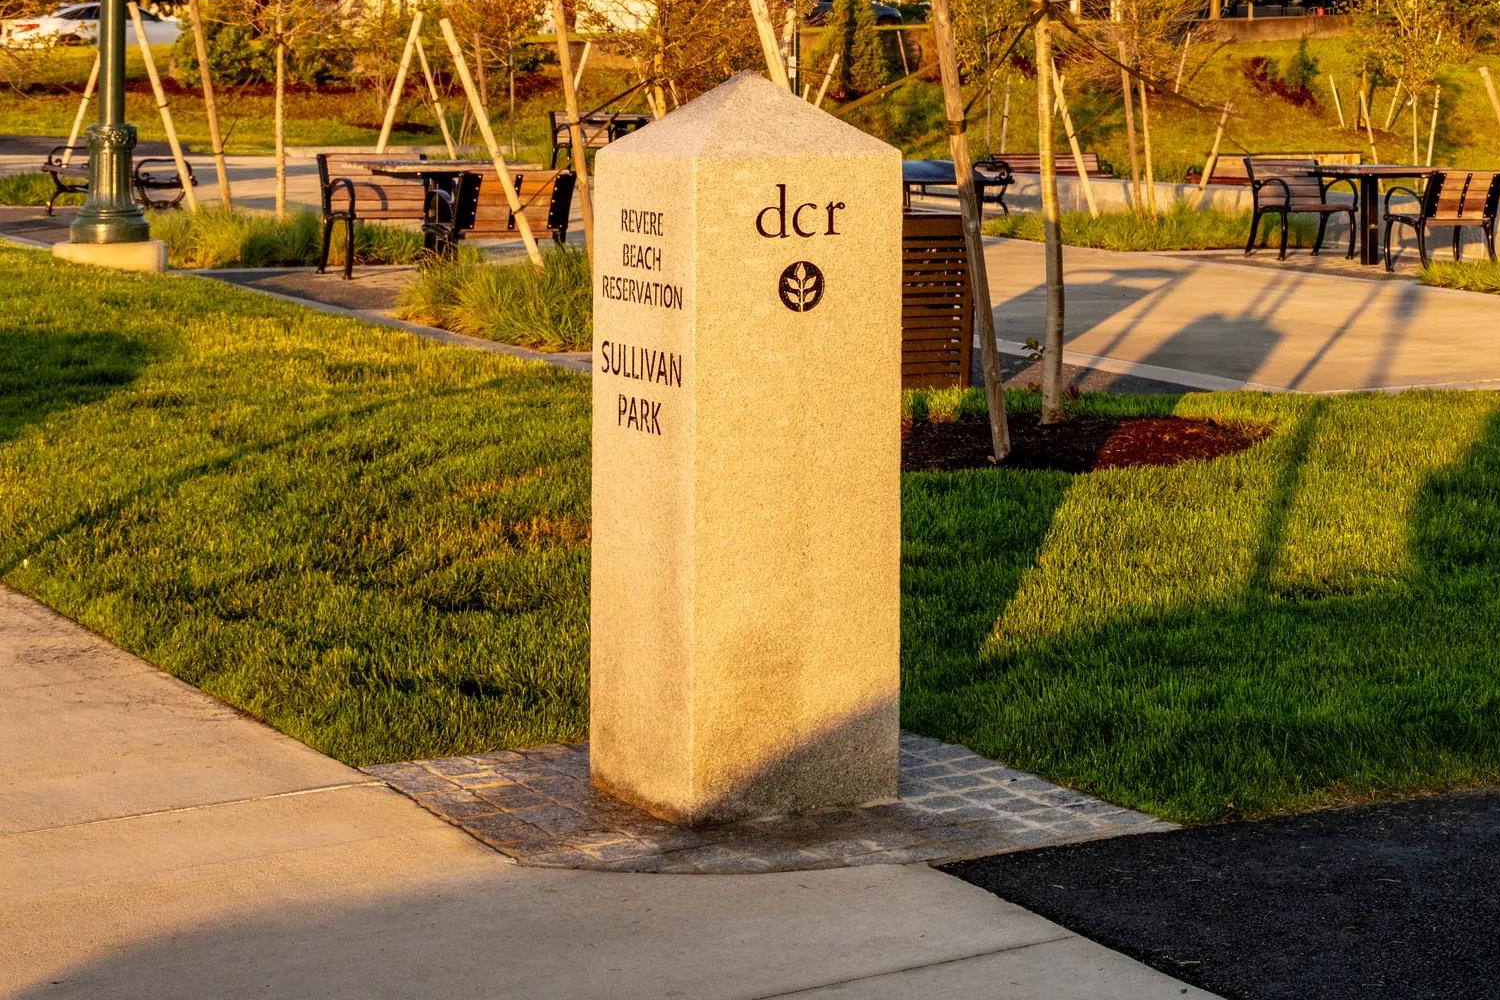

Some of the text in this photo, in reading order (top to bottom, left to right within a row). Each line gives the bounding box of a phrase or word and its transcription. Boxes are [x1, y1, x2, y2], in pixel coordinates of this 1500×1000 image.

[621, 208, 664, 236] REVERE
[755, 183, 846, 239] dcr
[622, 243, 662, 272] BEACH
[602, 275, 683, 310] RESERVATION
[601, 340, 682, 388] SULLIVAN
[618, 393, 662, 436] PARK
